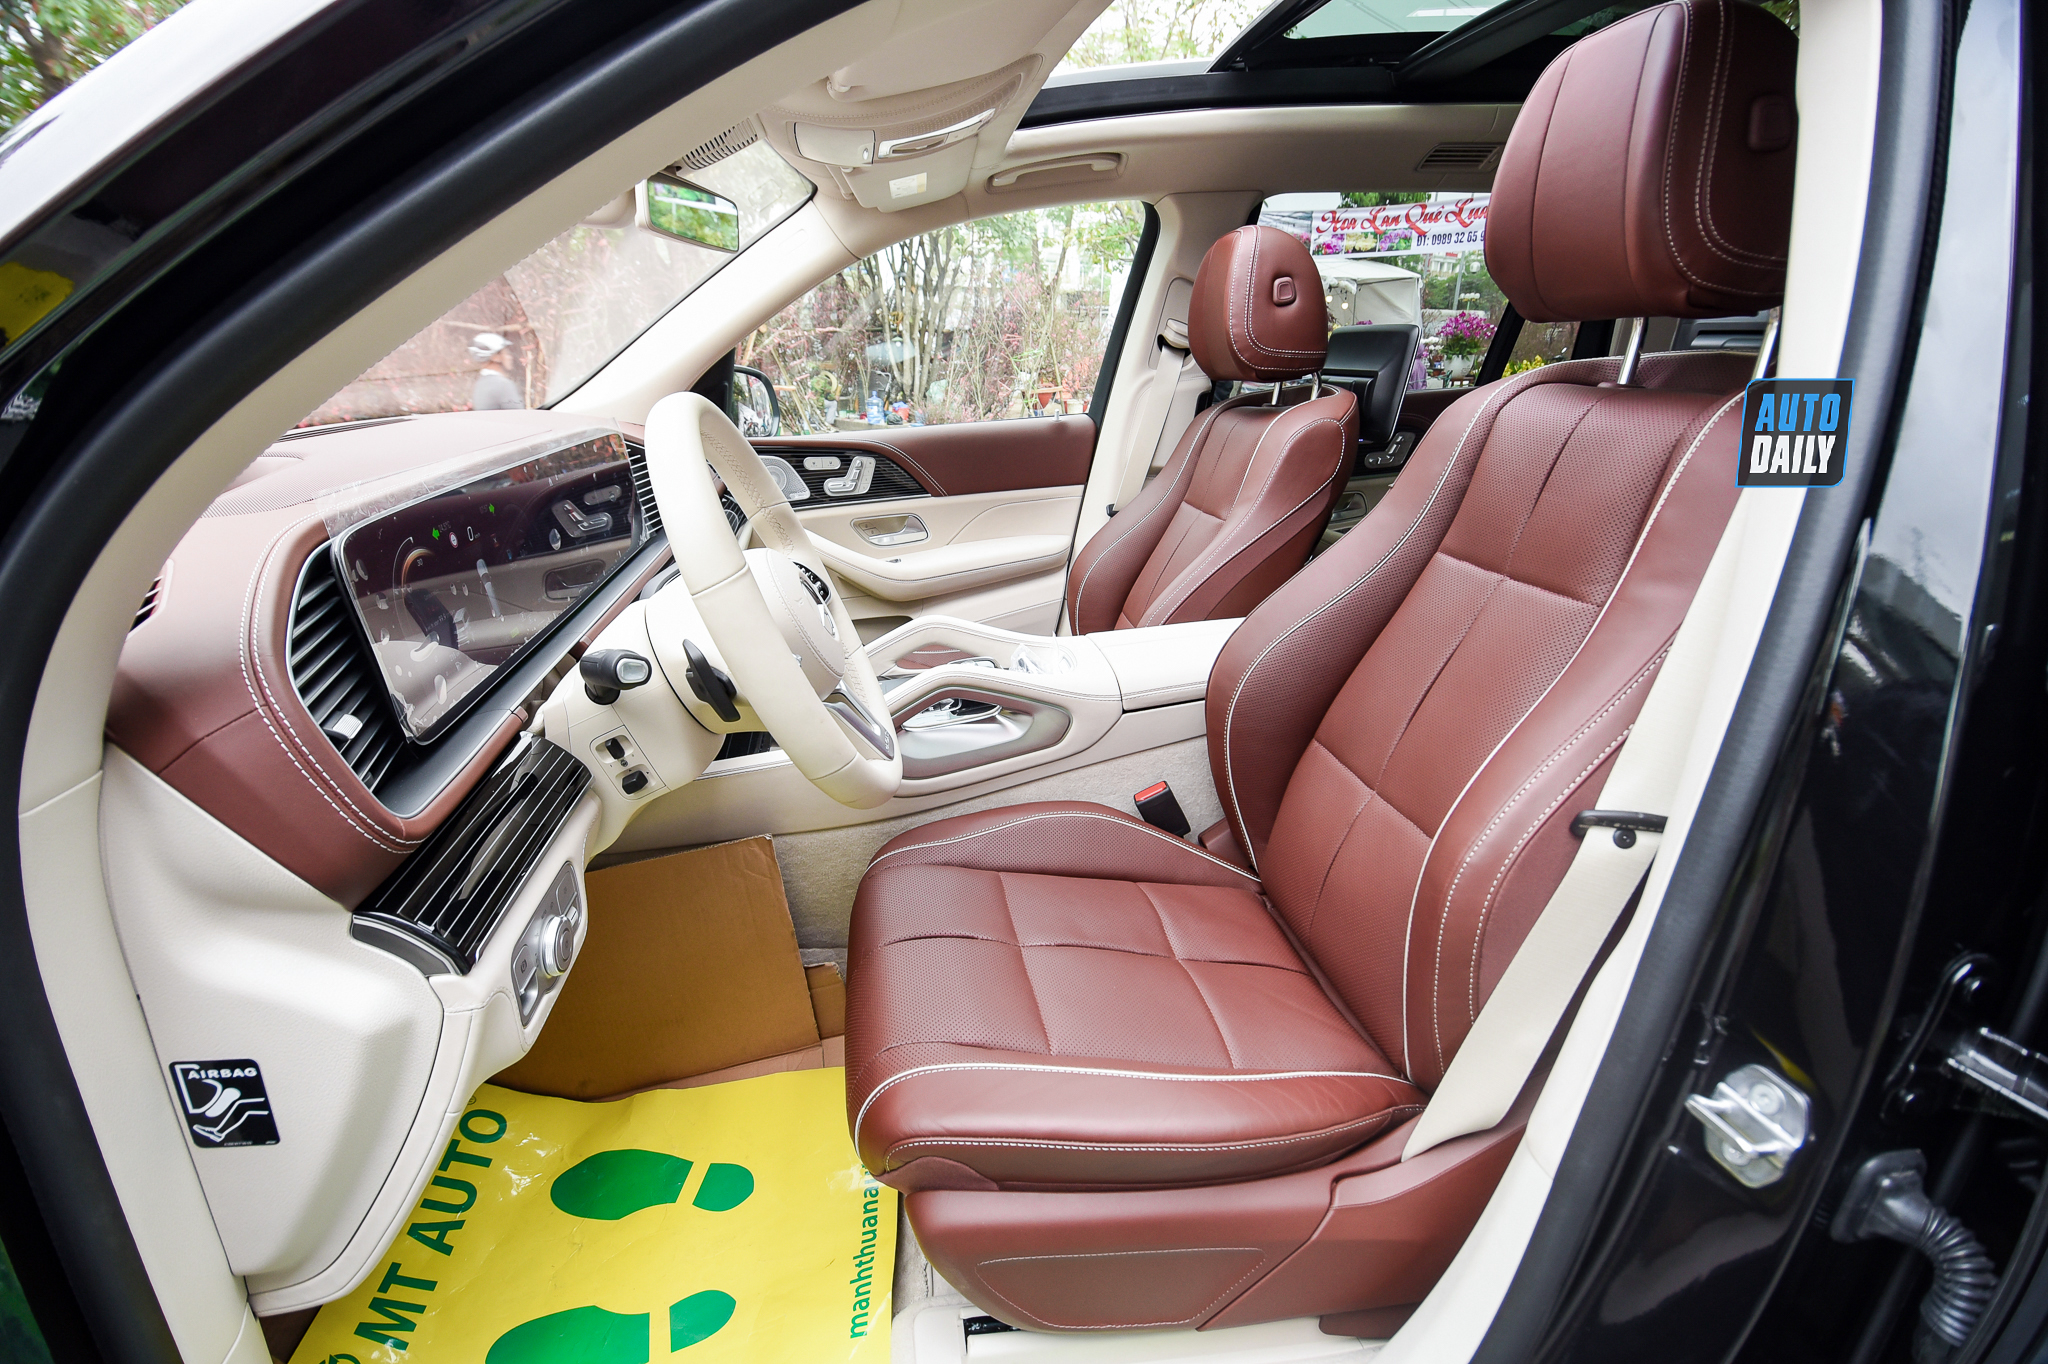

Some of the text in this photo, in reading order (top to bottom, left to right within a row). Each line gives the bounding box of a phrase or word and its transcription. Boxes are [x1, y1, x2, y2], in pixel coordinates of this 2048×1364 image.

[1316, 209, 1358, 233] Hoa
[1360, 207, 1401, 235] Lan
[1405, 203, 1444, 236] Quê
[1431, 233, 1453, 246] 0989
[1453, 231, 1466, 244] 32
[1466, 230, 1479, 243] 65
[187, 1067, 258, 1080] AIRBAG
[353, 1108, 508, 1352] MT AUTO
